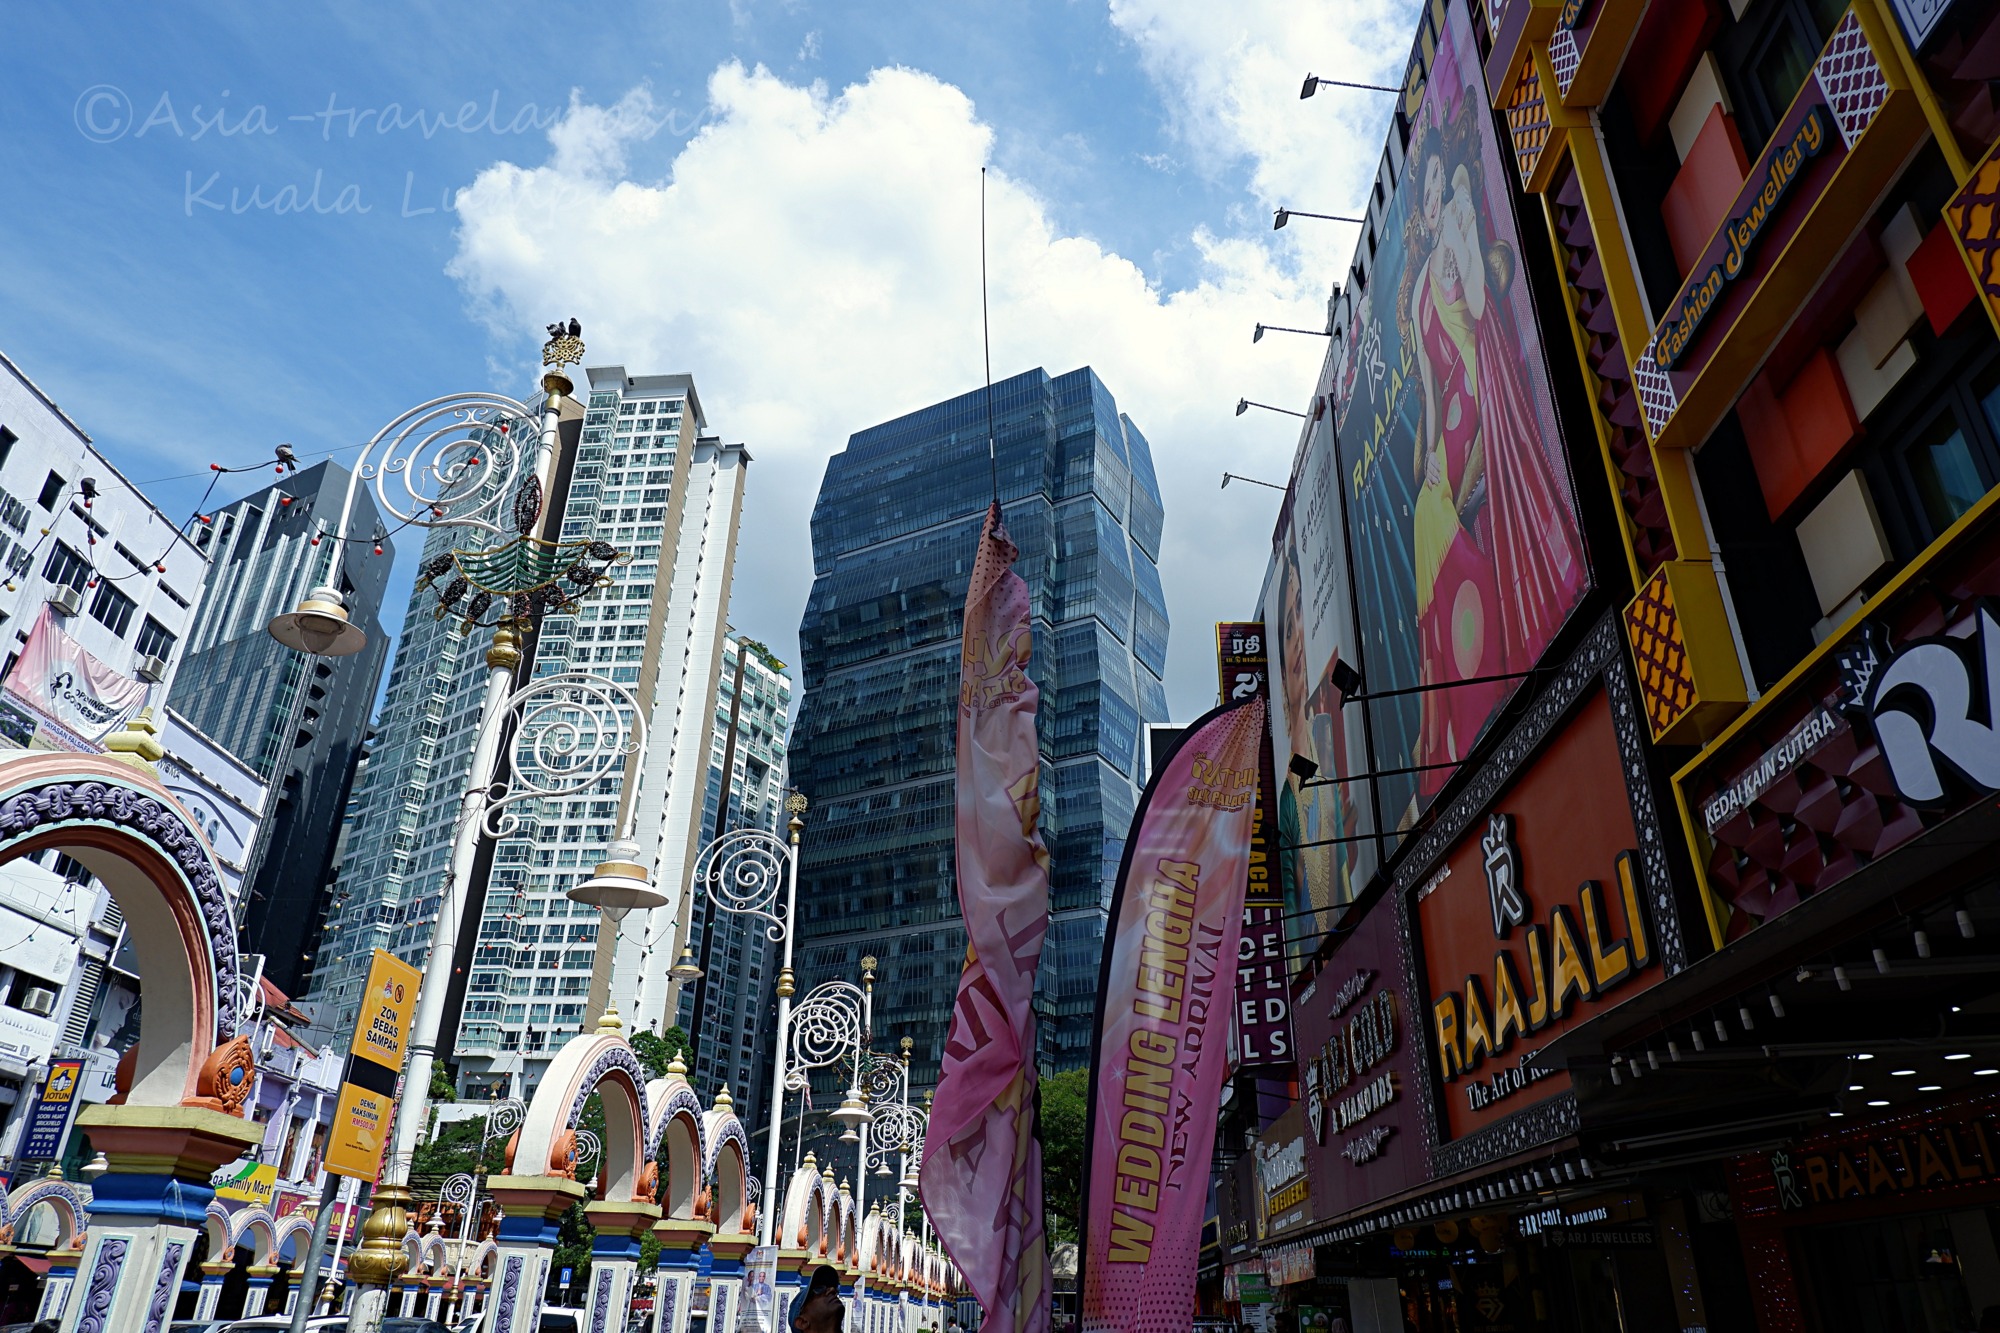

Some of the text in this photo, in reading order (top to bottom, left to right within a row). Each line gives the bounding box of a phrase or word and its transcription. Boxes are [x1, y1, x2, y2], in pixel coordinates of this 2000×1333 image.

[1657, 113, 1822, 367] Fashion Jewellery
[1353, 320, 1417, 500] RAAJALI
[1307, 490, 1317, 531] ARJ
[1318, 451, 1331, 498] GOLD
[1232, 634, 1260, 655] ரதி
[44, 719, 68, 739] YAYASAN
[1191, 757, 1256, 790] RATHI
[1704, 710, 1836, 828] KEDAI KAIN SUTERA
[1188, 786, 1211, 803] SILK
[1211, 791, 1251, 807] PALACE
[1433, 850, 1649, 1082] RAAJALI
[1262, 908, 1288, 1057] IELDS
[373, 1018, 399, 1038] BEBAS
[381, 1006, 398, 1023] ZON
[366, 1030, 398, 1053] SAMPAH
[1165, 915, 1227, 1191] NEW ARRIVAL
[1321, 988, 1394, 1100] ARJ GOLD
[1107, 857, 1201, 1264] WEDDING LENGHA
[45, 1092, 70, 1100] JOTUN
[1466, 1080, 1489, 1111] The
[1491, 1068, 1511, 1101] Art
[1512, 1056, 1527, 1088] of
[360, 1098, 376, 1110] DENDA
[1340, 1070, 1394, 1129] DIAMONDS
[352, 1106, 379, 1122] MAKSIMUM
[352, 1117, 376, 1131] RM500.00
[1804, 1119, 1997, 1203] RAAJALI
[225, 1174, 252, 1196] Family
[252, 1181, 272, 1197] Mart
[1572, 1207, 1608, 1226] DIAMONDS
[1568, 1231, 1652, 1244] ARJ JEWELLERS
